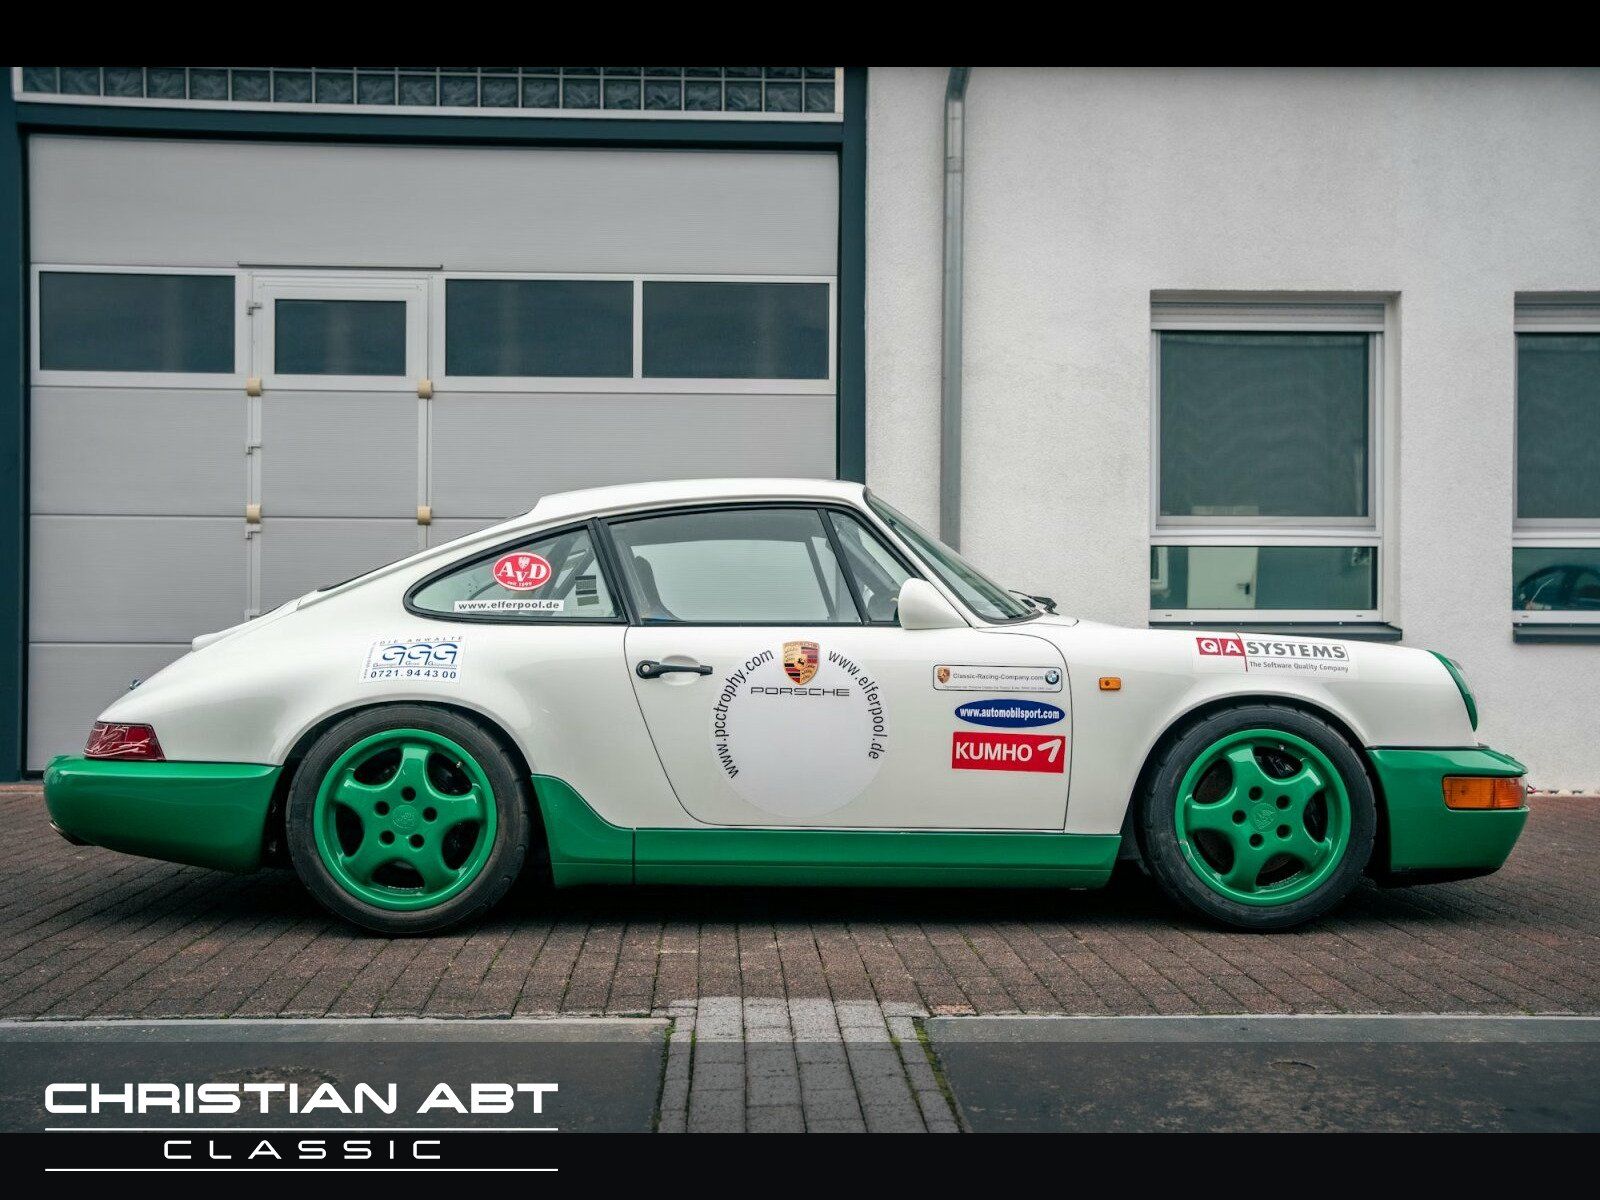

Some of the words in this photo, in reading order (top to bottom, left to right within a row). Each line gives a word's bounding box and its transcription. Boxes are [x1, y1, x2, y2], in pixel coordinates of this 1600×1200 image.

[459, 601, 560, 610] www.elferpool.de
[1200, 639, 1242, 654] QA
[1246, 642, 1346, 659] SYSTEMS
[1294, 663, 1318, 671] Quality
[1319, 664, 1349, 673] Company
[751, 687, 850, 696] PORSCHE
[828, 650, 888, 760] www.elferpool.de
[713, 649, 774, 778] www.pcctrophy.com
[960, 708, 1060, 720] www.automobilsport.com
[955, 741, 1033, 762] KUMHO
